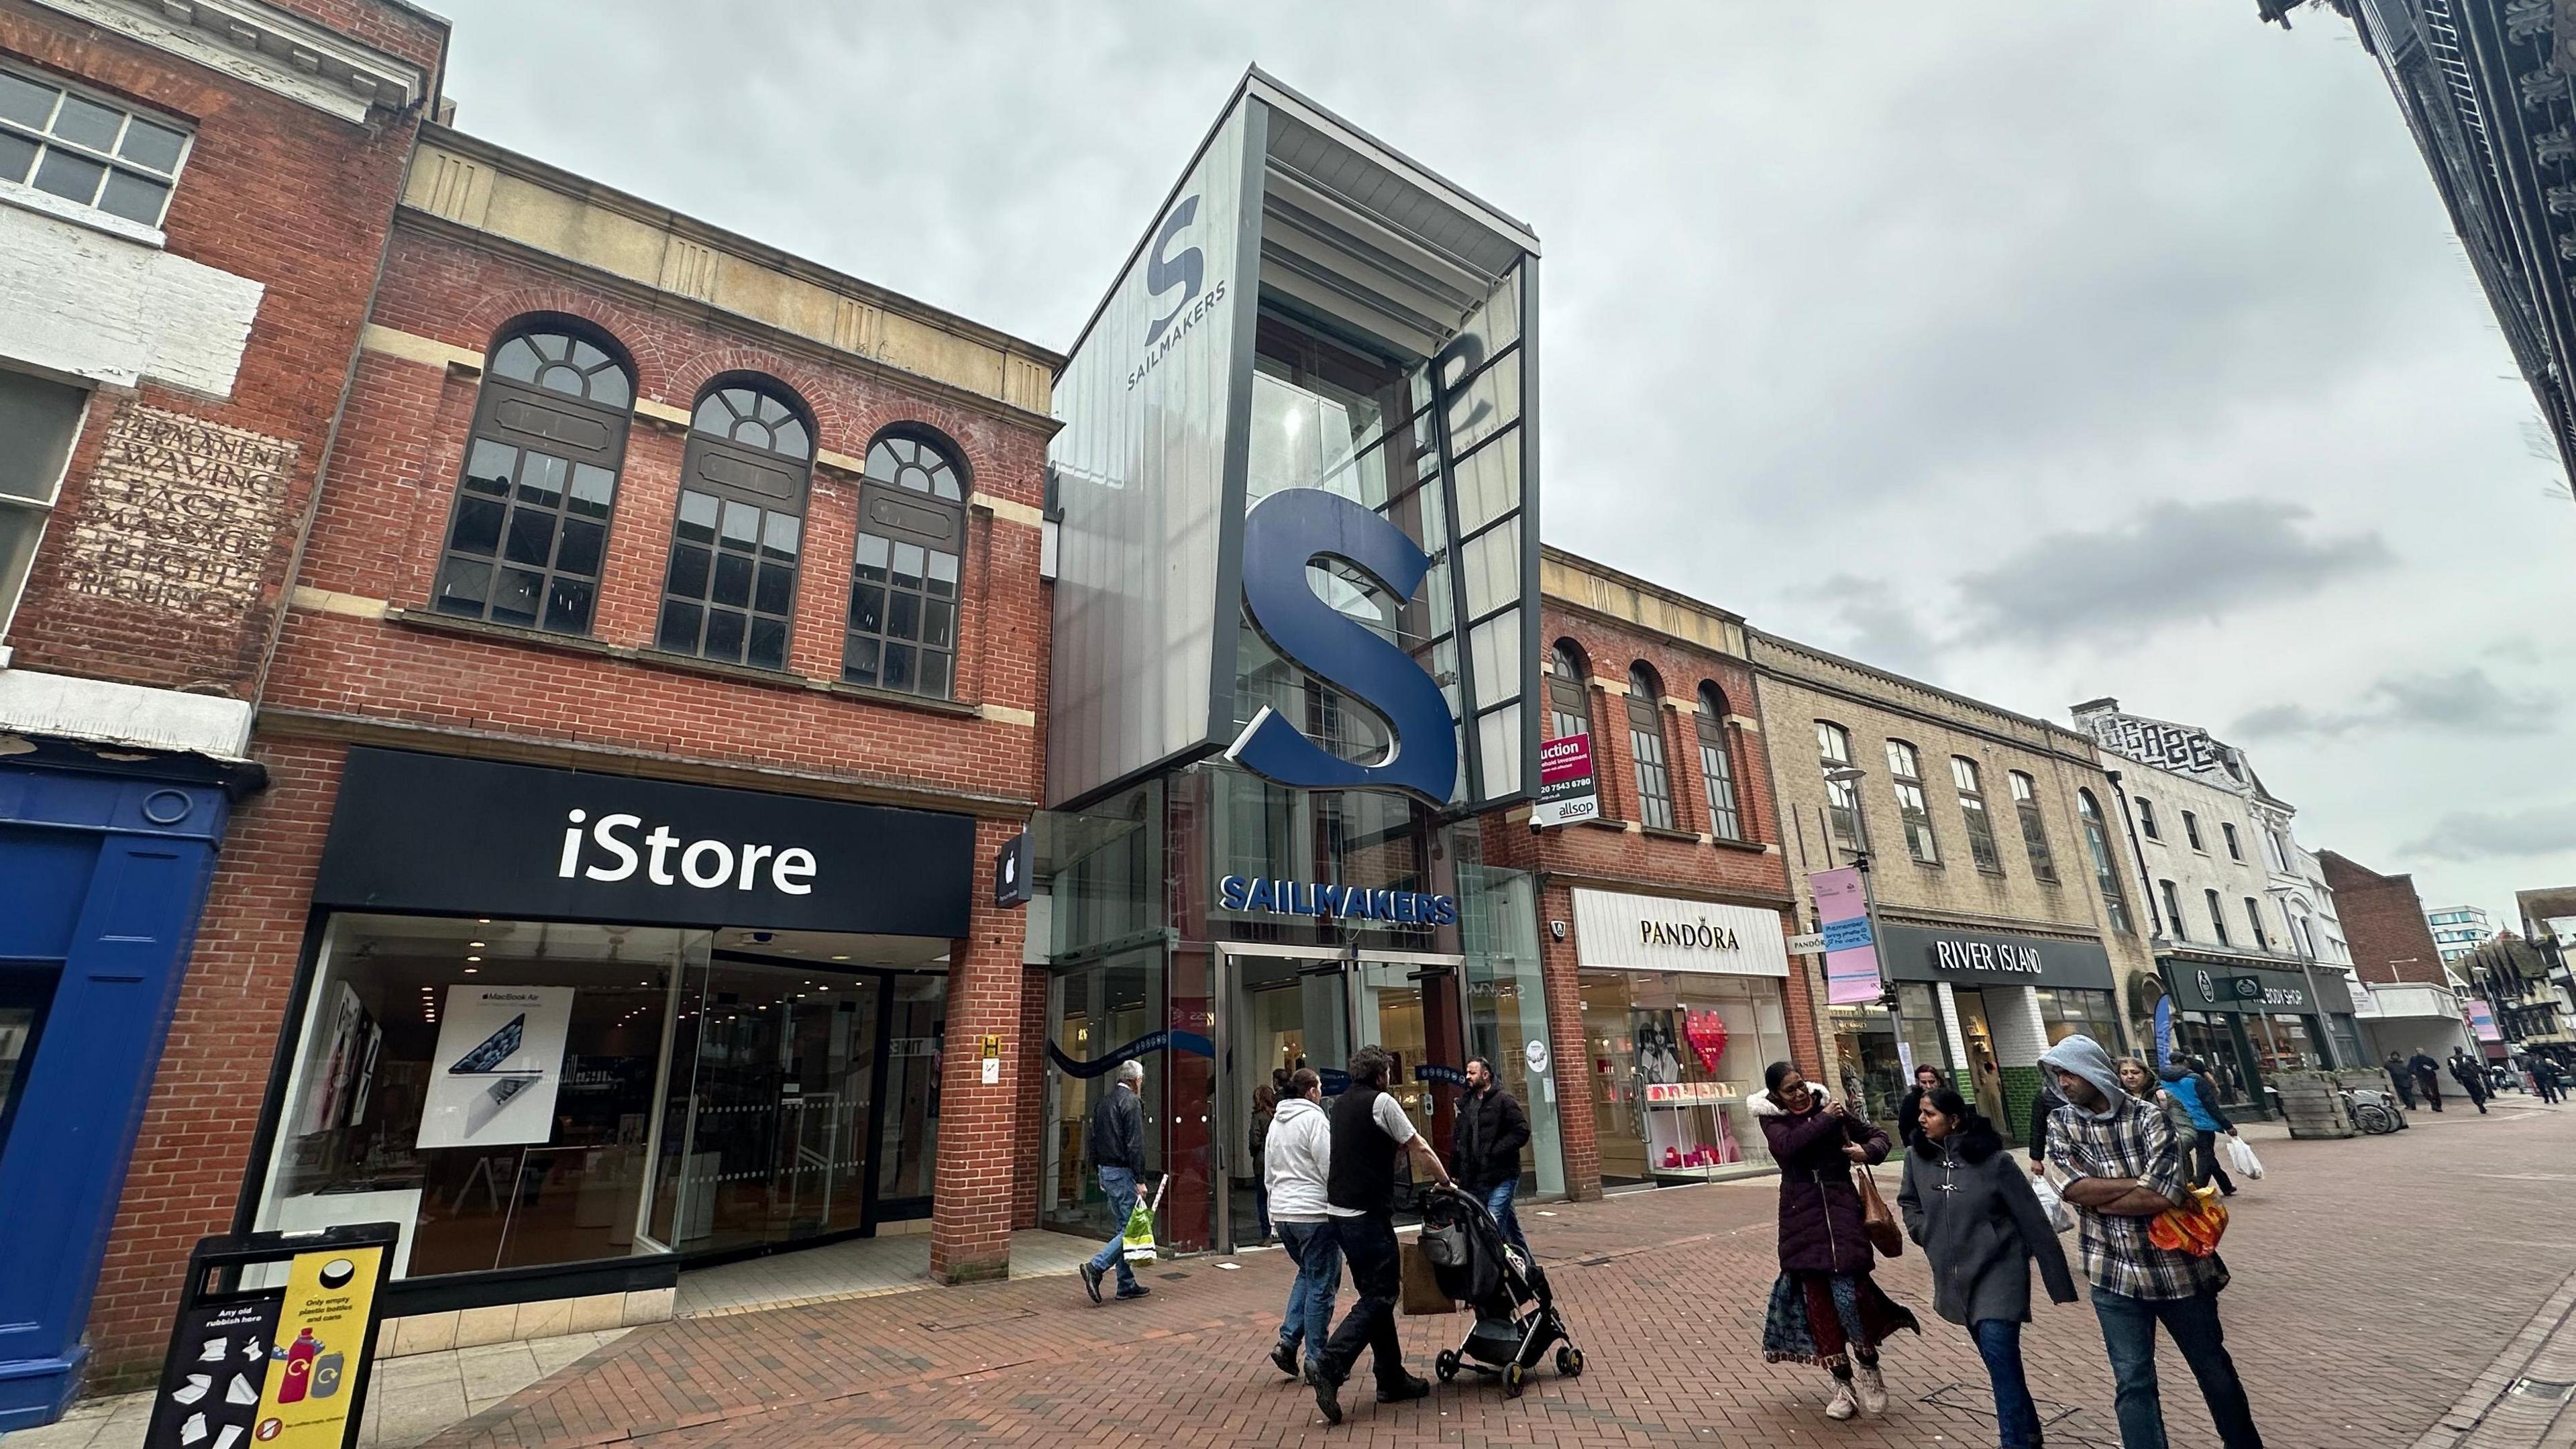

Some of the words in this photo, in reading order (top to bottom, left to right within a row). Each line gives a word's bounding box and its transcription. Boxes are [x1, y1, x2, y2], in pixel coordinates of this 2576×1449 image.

[1144, 195, 1203, 347] S
[1128, 280, 1226, 391] SAILMAKERS
[120, 415, 286, 474] PERMANENT
[119, 440, 272, 498] WAVING
[123, 478, 239, 525] FACE
[90, 500, 266, 557] MASSAGE
[1234, 488, 1458, 810] S
[1541, 743, 1579, 759] uction
[1552, 782, 1570, 791] 7543
[1559, 802, 1594, 816] allsop
[558, 808, 816, 895] iStore
[1220, 875, 1458, 926] SAILMAKERS
[1641, 920, 1740, 951] PANDORA
[1825, 921, 1864, 931] Remember
[1794, 940, 1826, 949] PANDOR
[1936, 941, 1996, 971] RIVER
[1996, 944, 2042, 973] ISLAND
[2282, 989, 2302, 1006] SHOP
[984, 1037, 999, 1056] H
[205, 1318, 241, 1328] rubbish
[218, 1309, 237, 1318] Any
[238, 1307, 253, 1315] old
[299, 1307, 325, 1317] plastic
